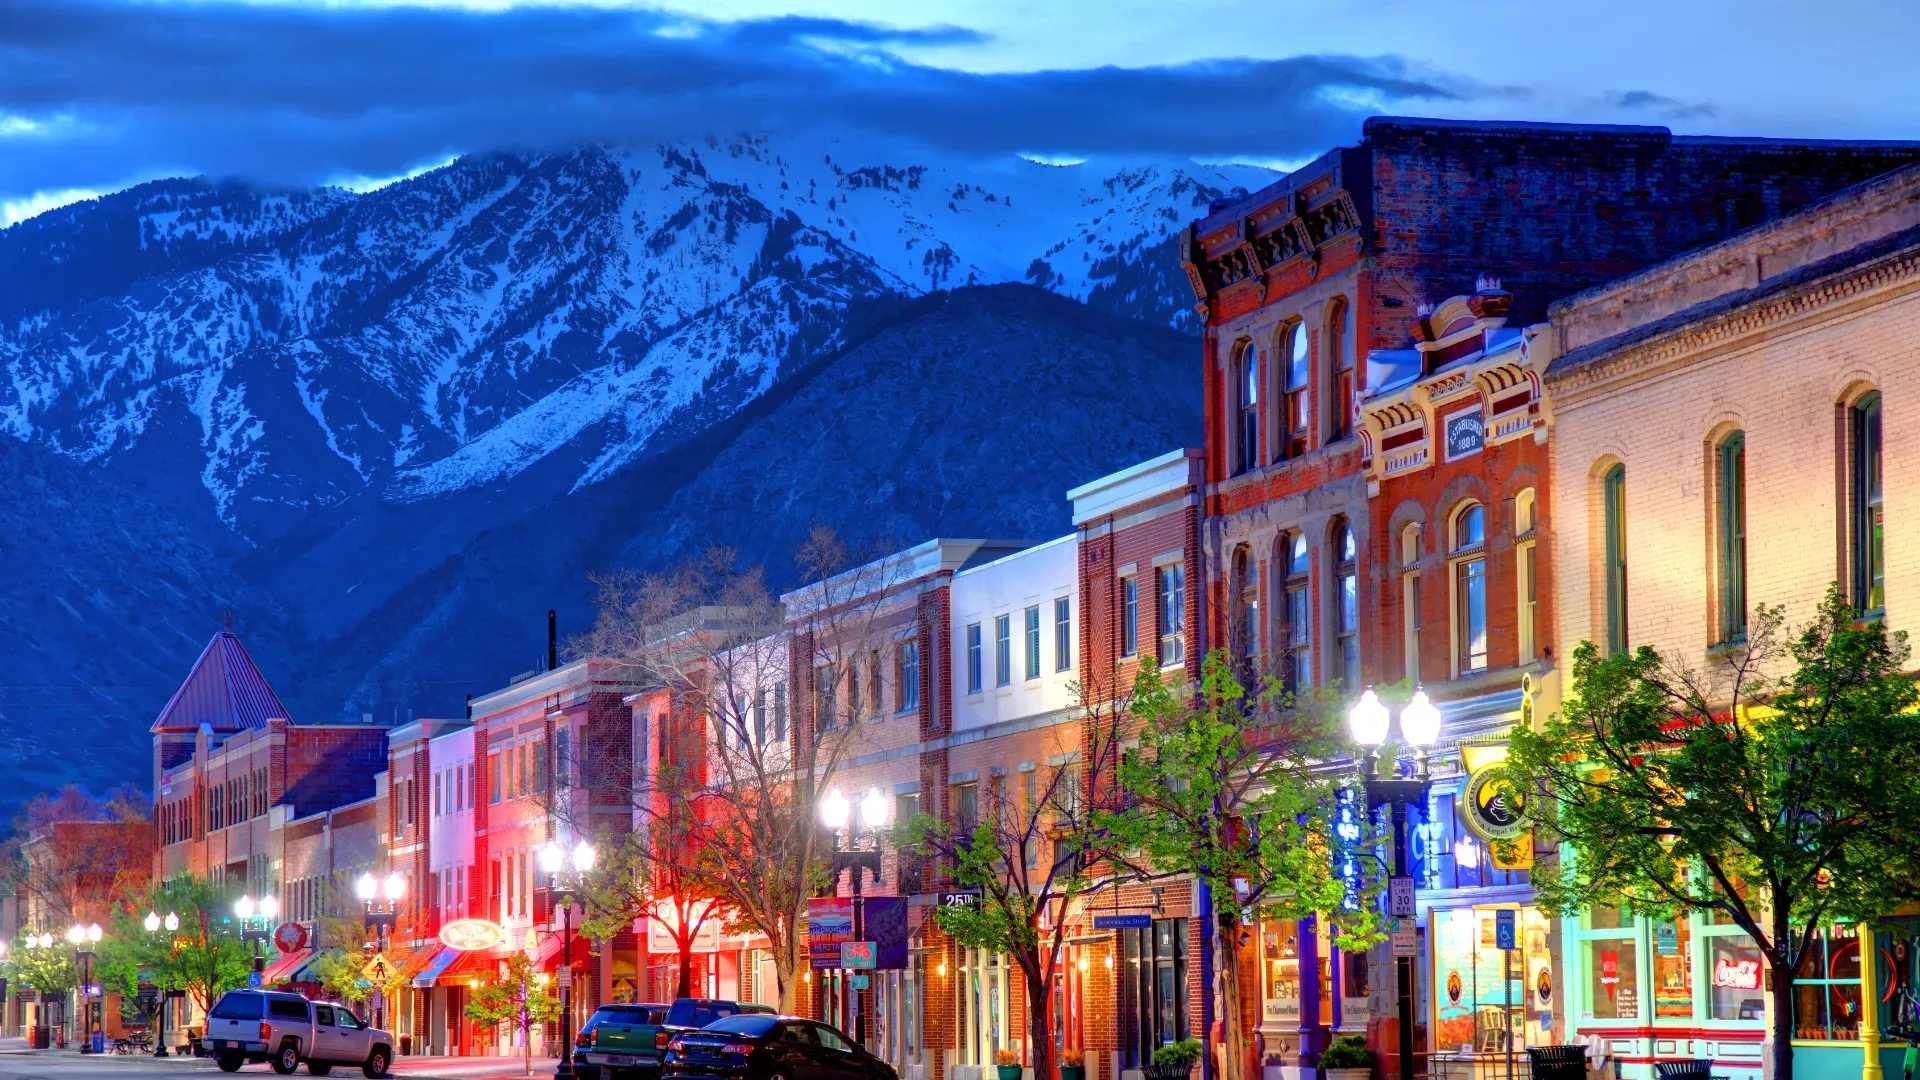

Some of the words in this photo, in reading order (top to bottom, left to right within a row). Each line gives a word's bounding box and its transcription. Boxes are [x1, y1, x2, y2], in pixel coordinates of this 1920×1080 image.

[1450, 419, 1482, 445] ESTABLISHED
[1459, 435, 1475, 451] 1889
[1487, 826, 1508, 837] Legal
[1396, 895, 1410, 905] 30
[1272, 1005, 1288, 1015] Diamond
